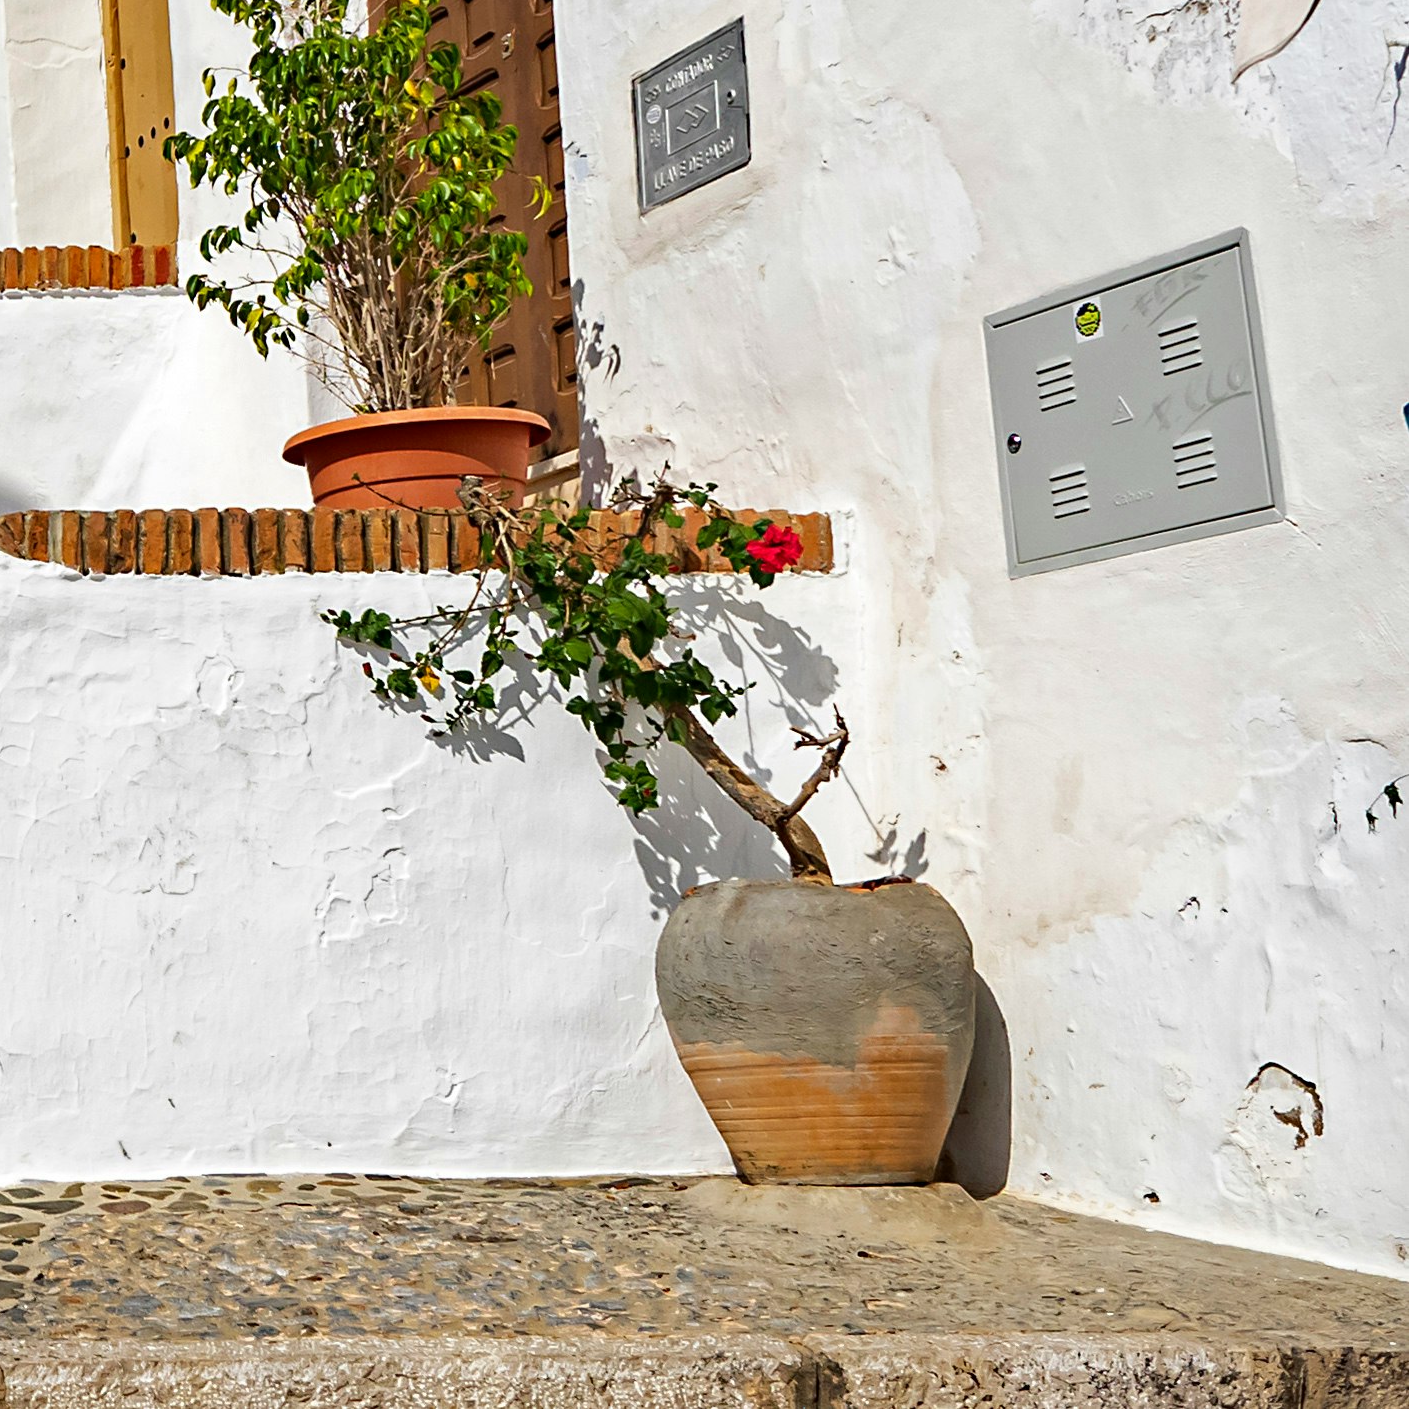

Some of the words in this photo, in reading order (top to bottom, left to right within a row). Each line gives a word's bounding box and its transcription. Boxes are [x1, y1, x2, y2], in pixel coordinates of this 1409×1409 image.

[654, 161, 687, 191] LLAVE
[688, 151, 703, 173] DE
[705, 135, 734, 165] PASO
